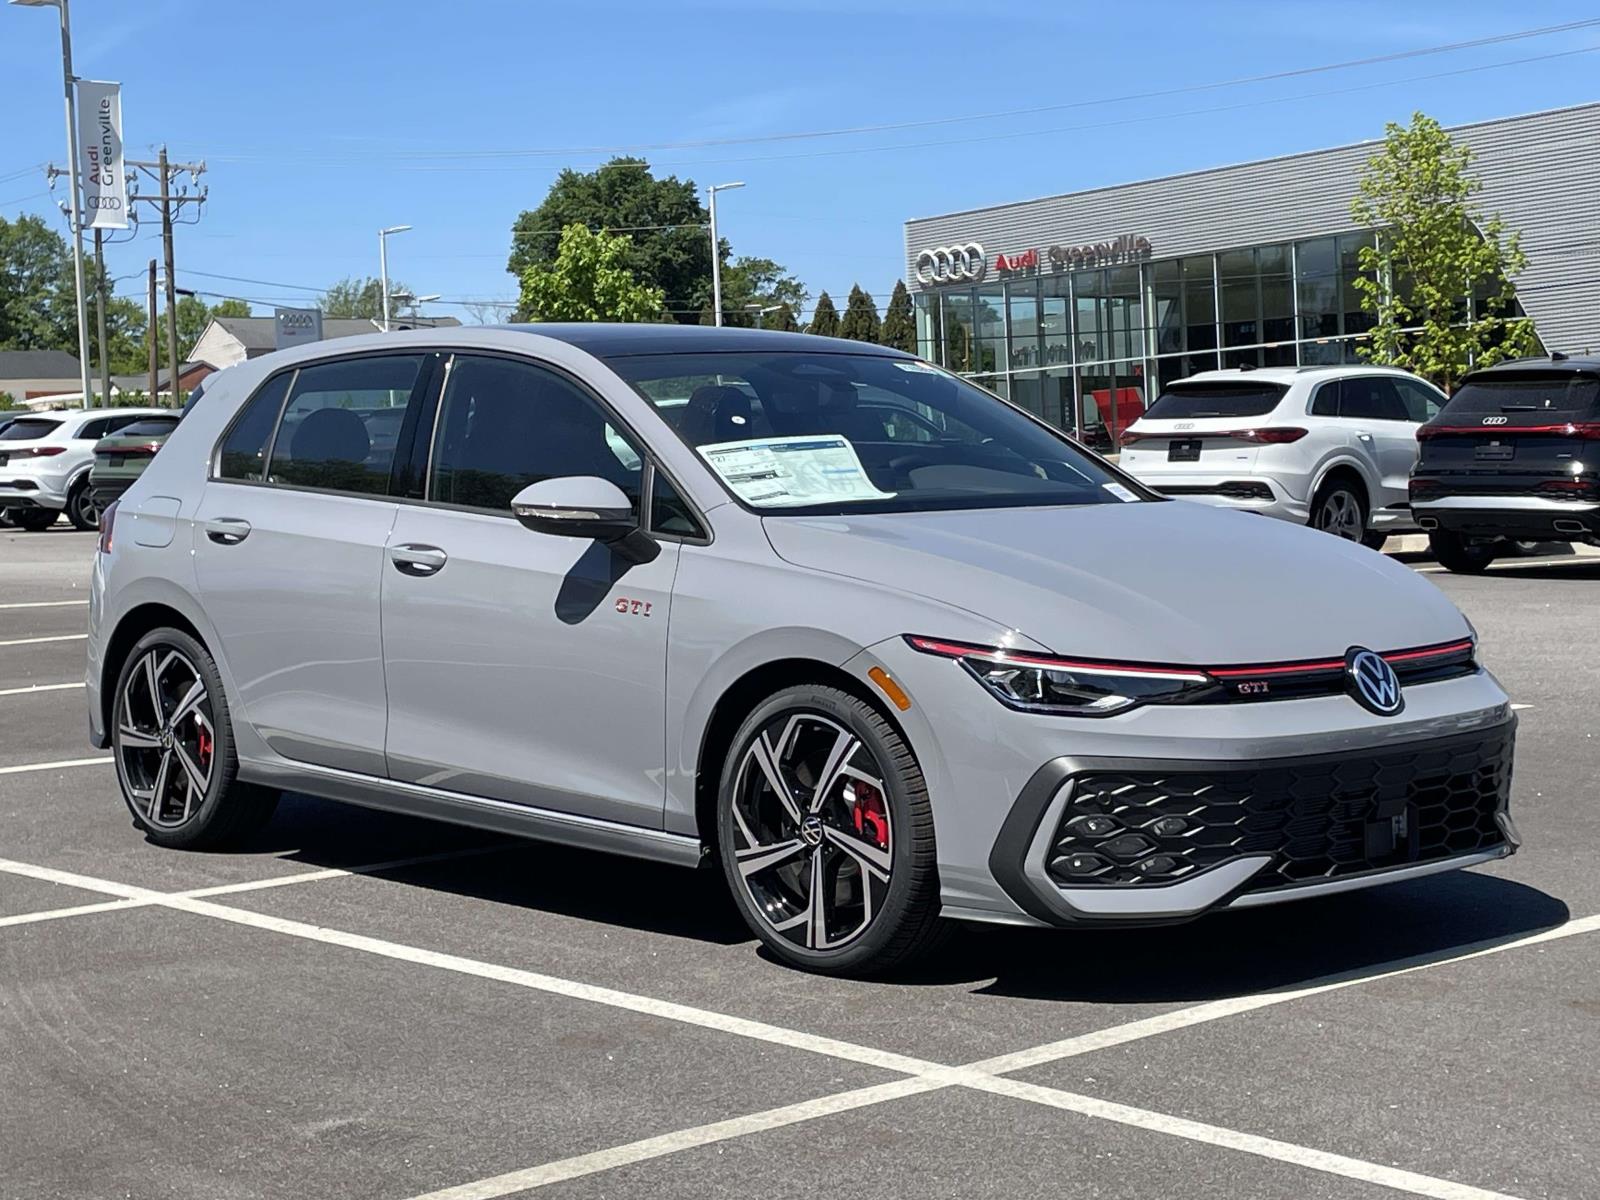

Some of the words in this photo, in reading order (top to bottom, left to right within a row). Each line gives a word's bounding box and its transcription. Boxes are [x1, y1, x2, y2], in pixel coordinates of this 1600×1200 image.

[99, 99, 113, 186] Greenville
[87, 146, 100, 185] Audi
[995, 248, 1038, 272] Audi
[1047, 234, 1151, 265] Greenville
[616, 598, 652, 617] GTI
[1237, 681, 1269, 694] GTI
